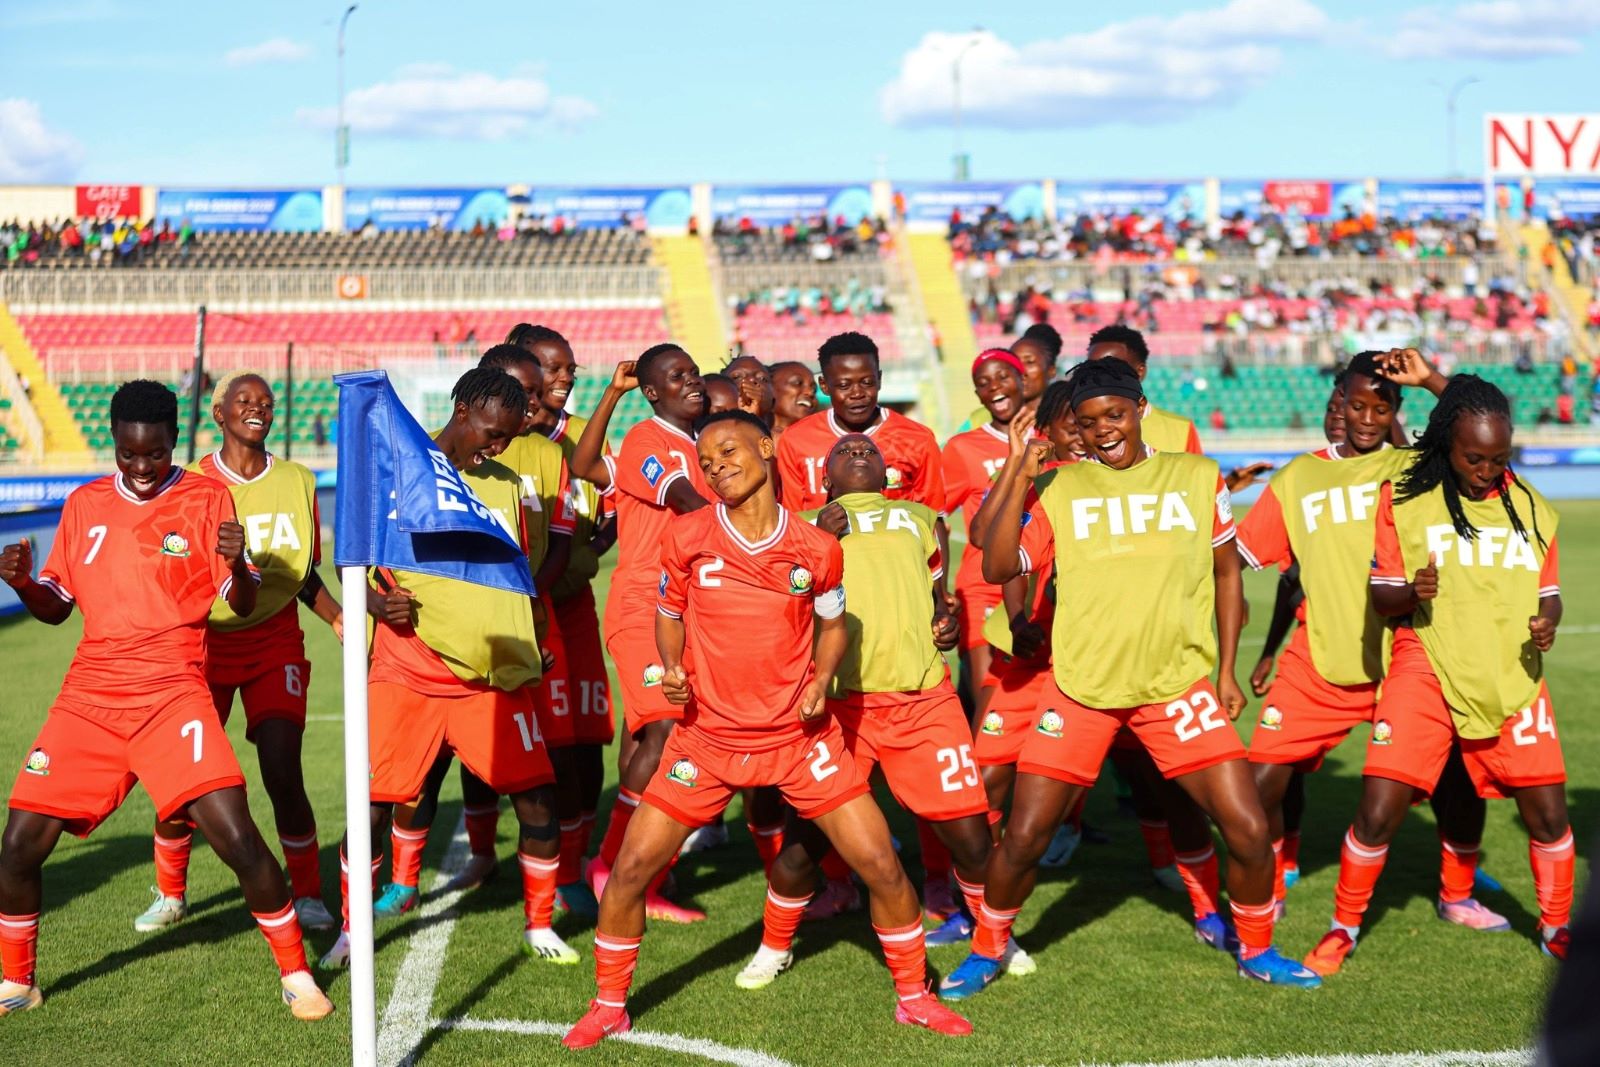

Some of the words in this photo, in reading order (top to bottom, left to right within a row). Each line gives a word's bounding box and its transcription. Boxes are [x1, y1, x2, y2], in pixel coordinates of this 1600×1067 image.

[1071, 492, 1197, 540] FIFA
[1301, 481, 1378, 534] FIF
[83, 525, 107, 565] 7
[699, 556, 724, 587] 2
[284, 664, 302, 697] 6
[550, 679, 569, 716] 5
[580, 681, 608, 715] 16
[1166, 691, 1226, 742] 22
[1512, 697, 1556, 746] 24
[181, 719, 203, 763] 7
[806, 741, 839, 782] 2
[937, 744, 978, 792] 25
